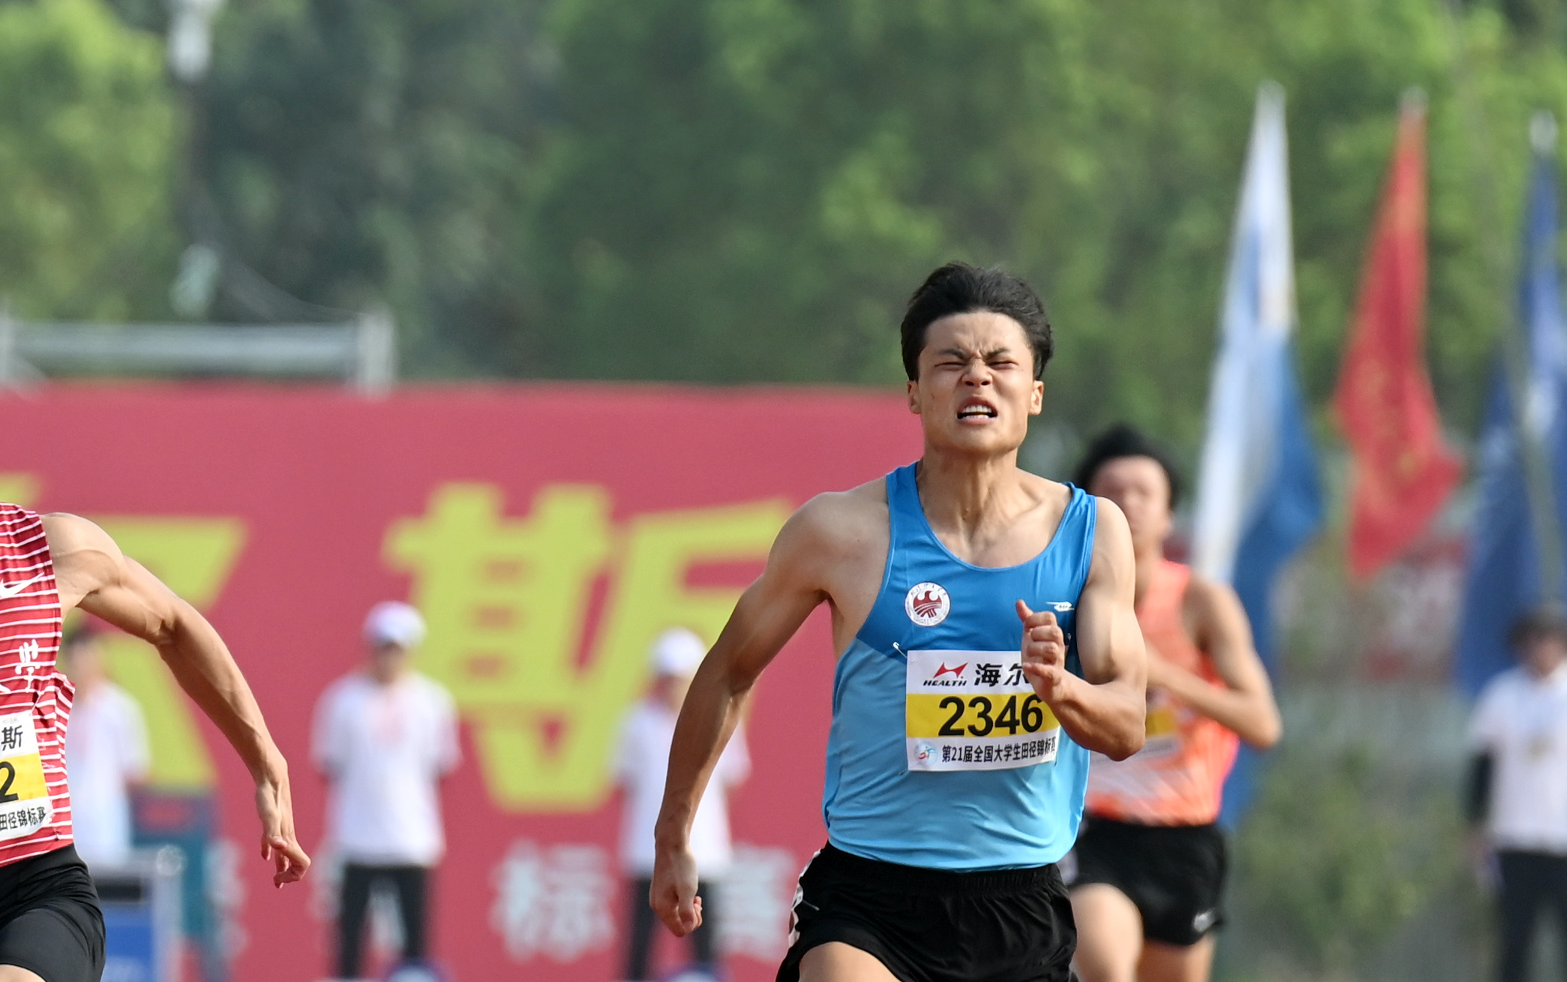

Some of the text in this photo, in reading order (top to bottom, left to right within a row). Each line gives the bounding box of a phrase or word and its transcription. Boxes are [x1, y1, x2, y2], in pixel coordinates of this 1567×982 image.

[922, 679, 967, 687] HEALTH
[973, 662, 1031, 688] 海尔
[938, 693, 1044, 737] 2346
